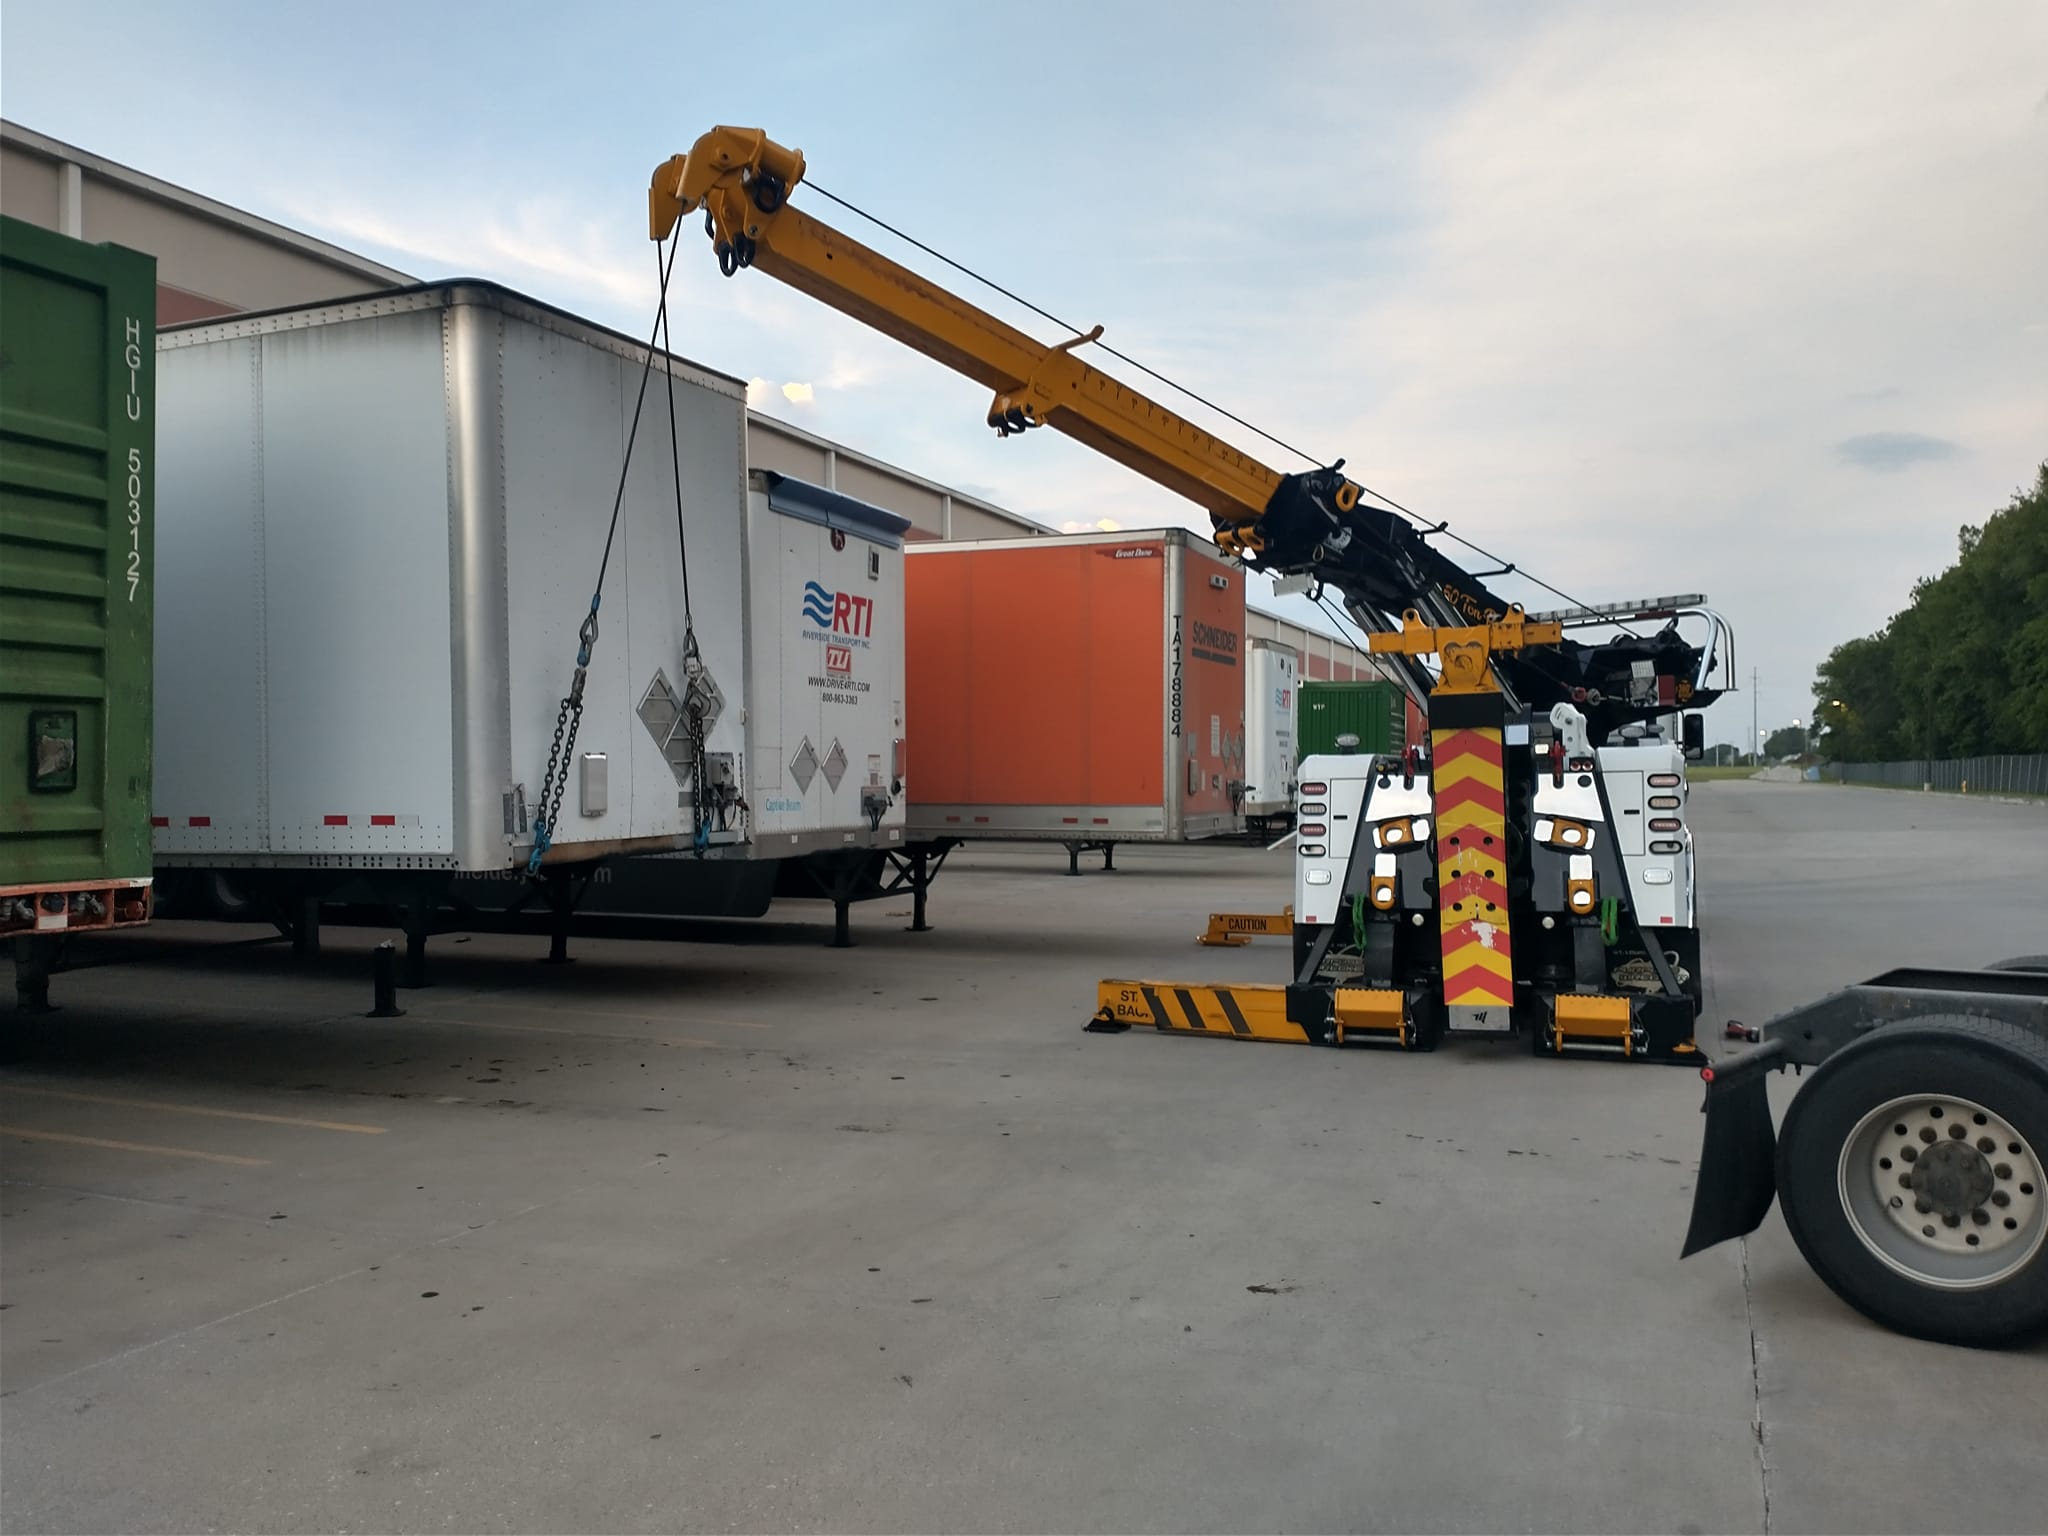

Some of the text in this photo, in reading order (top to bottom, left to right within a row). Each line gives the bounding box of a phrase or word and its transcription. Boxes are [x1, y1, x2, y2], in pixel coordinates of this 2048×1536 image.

[125, 316, 141, 602] HGIU 503127
[833, 591, 873, 638] RTI
[802, 629, 830, 642] RIVERSIDE
[831, 634, 861, 647] TRANSPORT
[1192, 620, 1238, 654] SCHNEIDER
[808, 676, 871, 693] WWW.DRIVE4RTI.COM
[1171, 615, 1182, 738] TA178884
[1228, 918, 1267, 931] CAUTION
